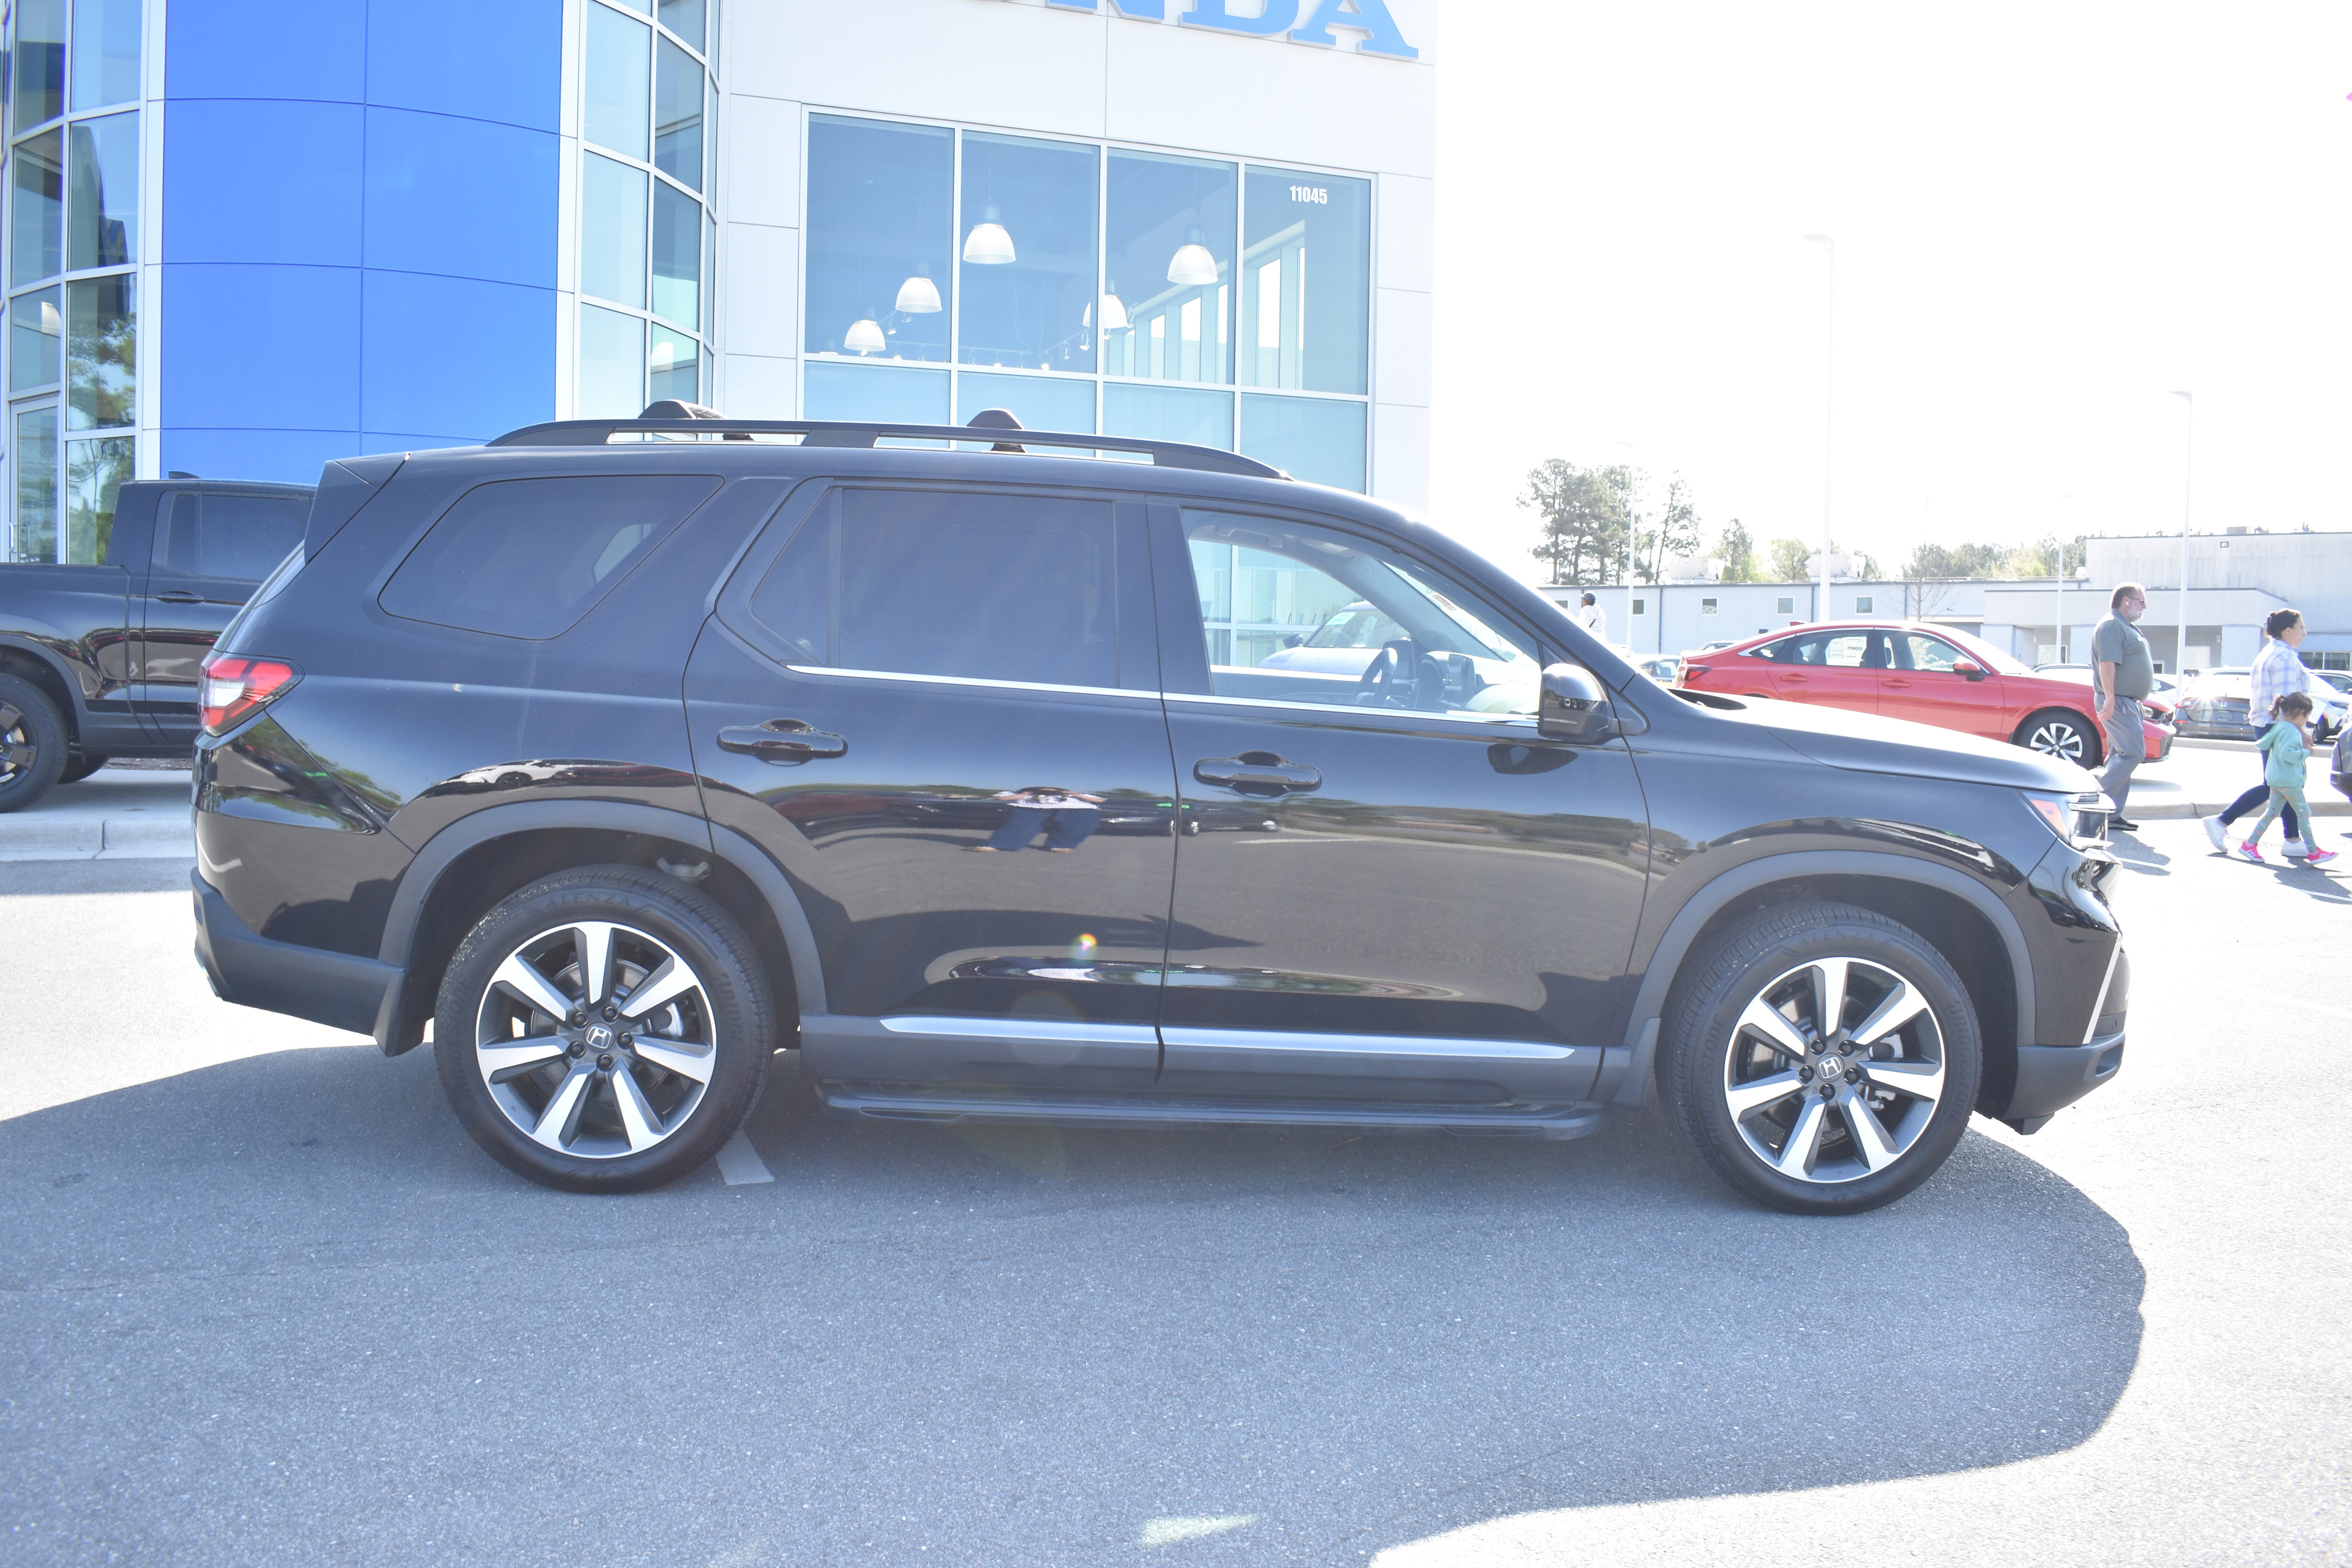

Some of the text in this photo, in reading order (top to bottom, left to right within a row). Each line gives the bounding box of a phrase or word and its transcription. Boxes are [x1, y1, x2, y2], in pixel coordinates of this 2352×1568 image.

[1289, 185, 1328, 205] 11045
[548, 892, 630, 908] ALENZA
[1798, 930, 1875, 946] ALENZA
[715, 973, 743, 1109] BRIDGESTONE
[1946, 1001, 1972, 1124] BRIDGESTONE
[1699, 1014, 1728, 1144] BRIDGESTONE
